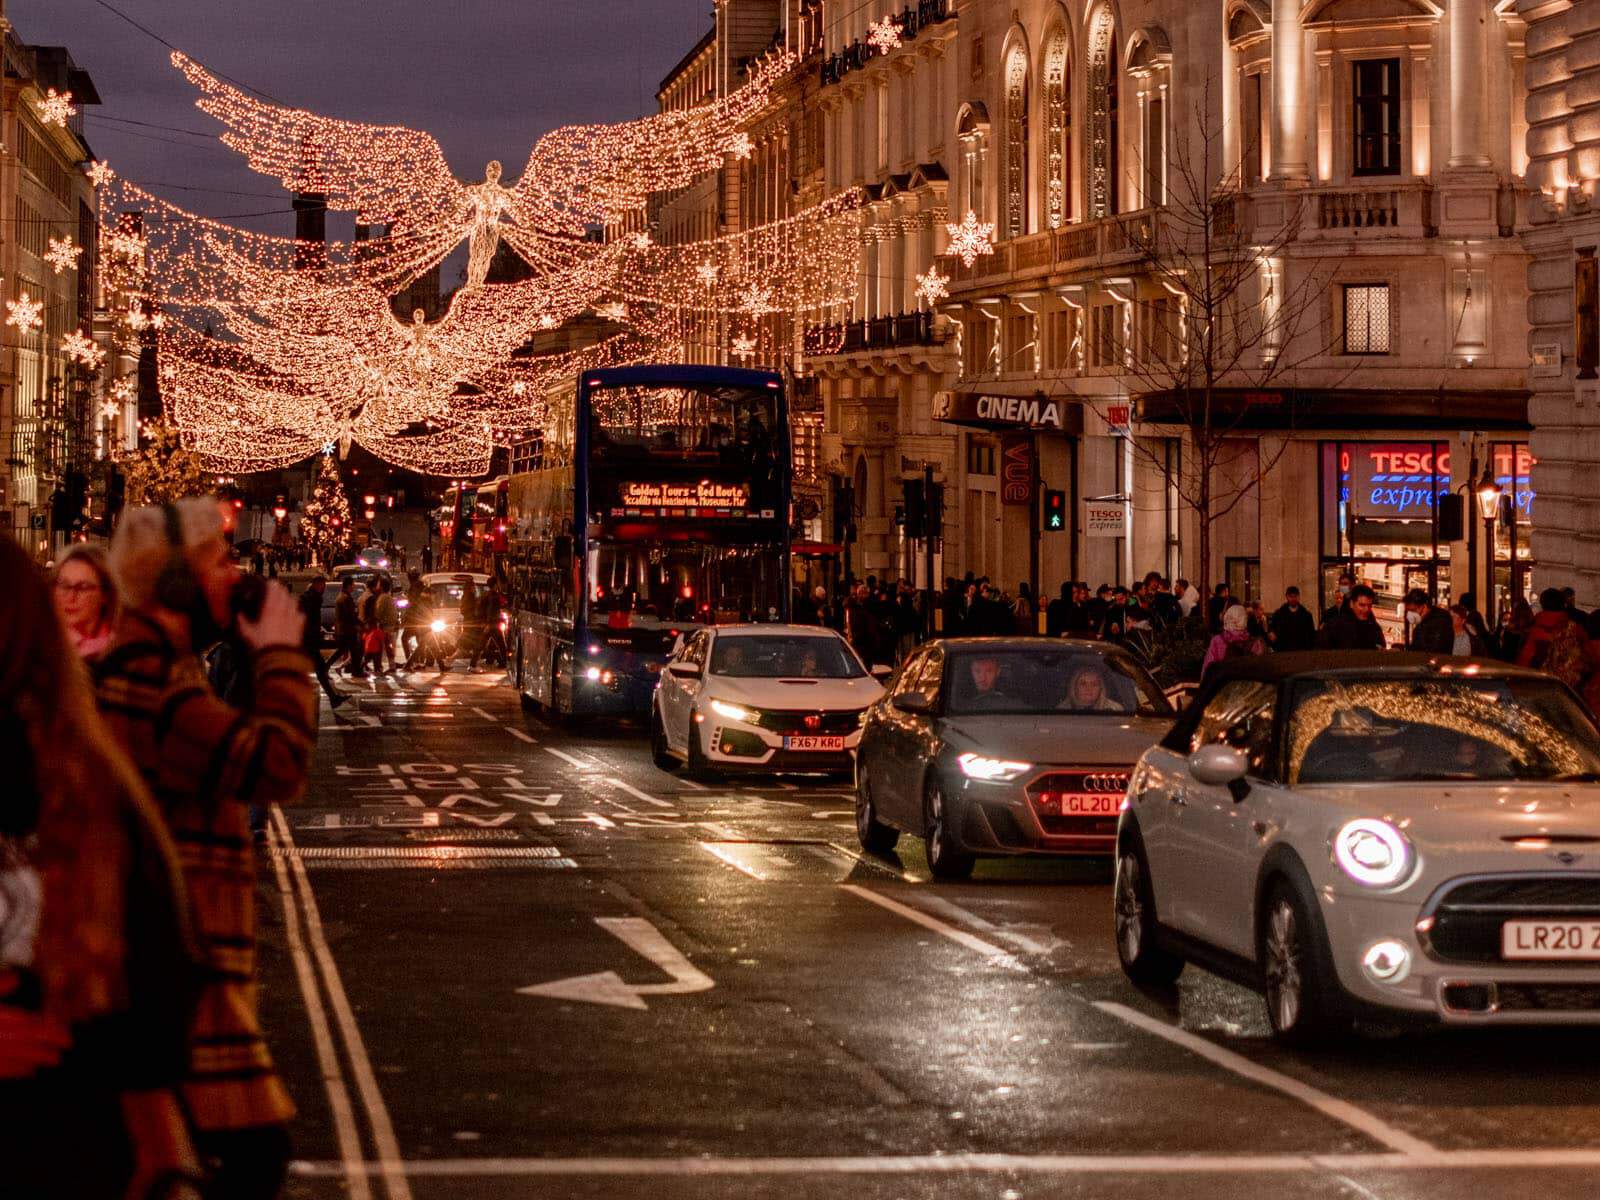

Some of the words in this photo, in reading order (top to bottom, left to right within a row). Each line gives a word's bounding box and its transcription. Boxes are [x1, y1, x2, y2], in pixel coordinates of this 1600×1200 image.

[976, 395, 1061, 426] CINEMA
[629, 483, 660, 496] Golden
[661, 484, 689, 496] Tours
[697, 484, 714, 497] Red
[715, 485, 743, 497] Route
[1089, 510, 1122, 518] TESCO
[790, 737, 818, 748] FX67
[821, 737, 841, 748] KRG
[1069, 796, 1110, 812] GL20
[1516, 926, 1583, 950] LR20
